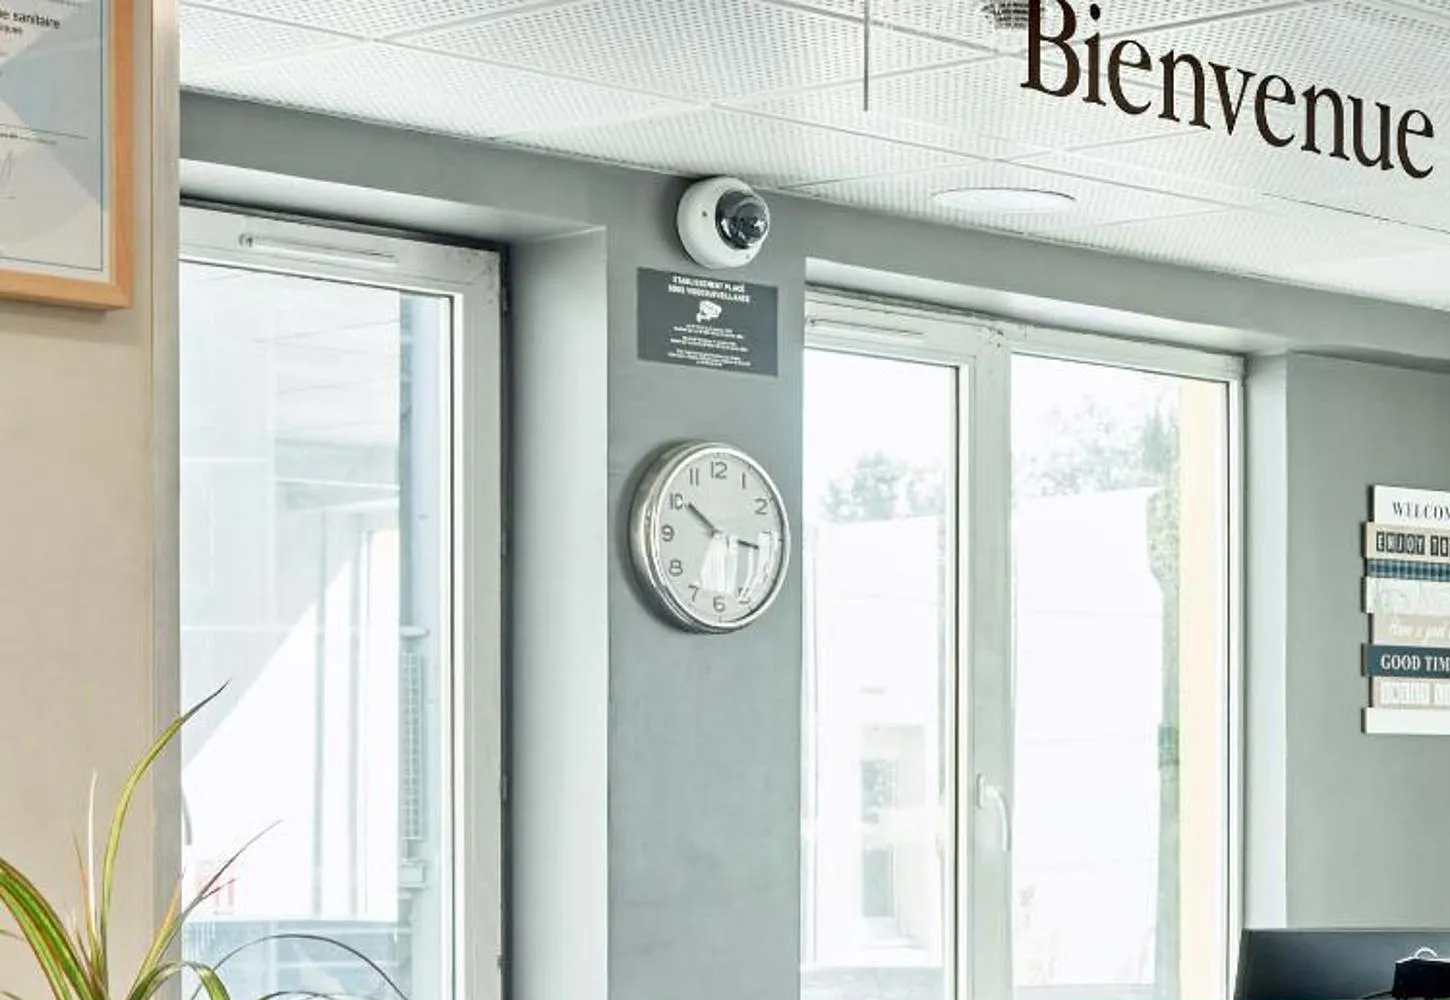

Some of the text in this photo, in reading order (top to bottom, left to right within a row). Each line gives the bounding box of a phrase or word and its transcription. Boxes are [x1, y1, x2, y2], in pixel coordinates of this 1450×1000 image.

[1021, 0, 1435, 179] Bienvenue
[689, 468, 700, 486] 11
[710, 461, 728, 480] 12
[669, 493, 684, 511] 10
[754, 498, 768, 515] 2
[661, 525, 675, 542] 9
[669, 559, 684, 577] 8
[688, 584, 701, 602] 7
[713, 596, 726, 612] 6
[1380, 654, 1421, 671] GOOD
